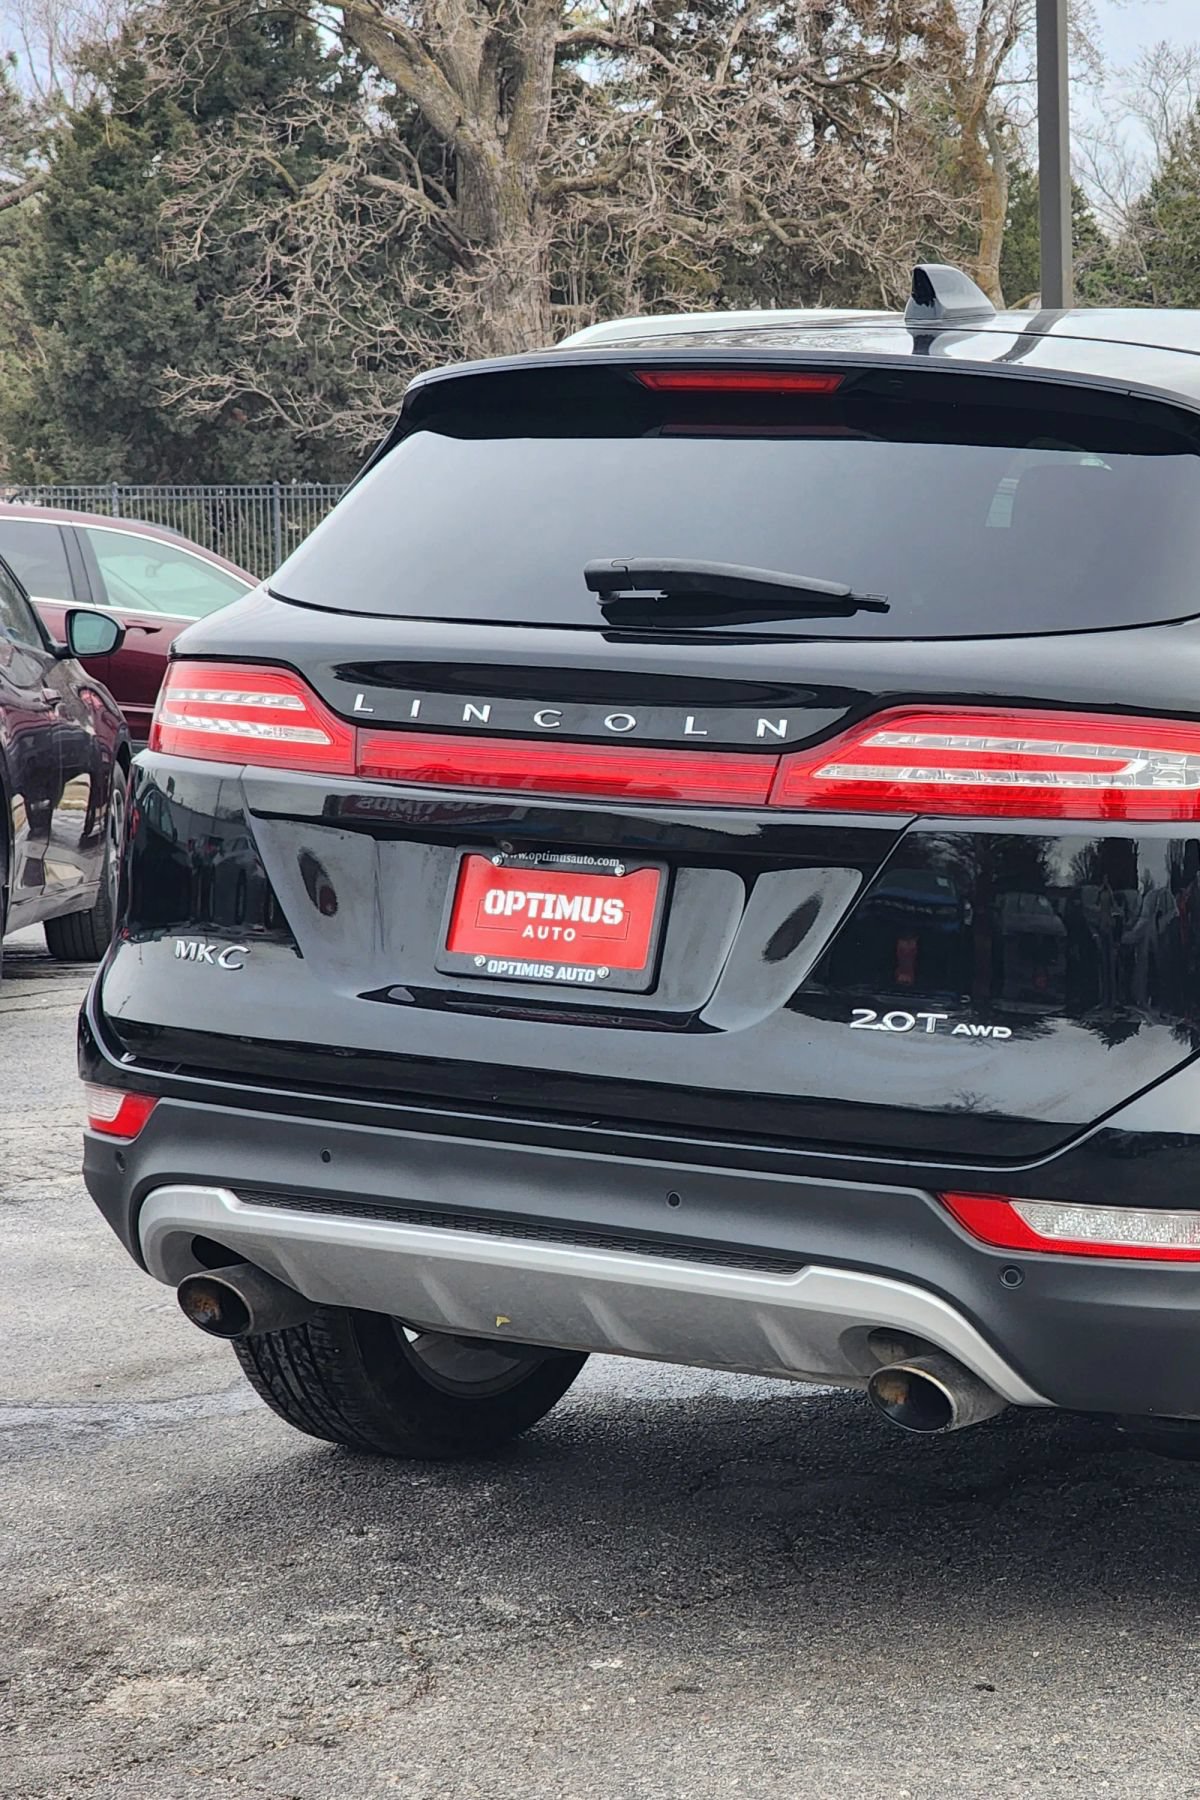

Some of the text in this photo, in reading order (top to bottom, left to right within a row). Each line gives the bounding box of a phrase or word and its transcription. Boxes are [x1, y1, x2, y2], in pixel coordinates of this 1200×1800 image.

[353, 693, 788, 739] LINCOLN
[483, 889, 624, 925] OPTIMUS
[521, 924, 577, 942] AUTO
[175, 939, 251, 971] MKC
[486, 959, 596, 983] OPTIMUS AUTO
[951, 1023, 1013, 1040] AWD
